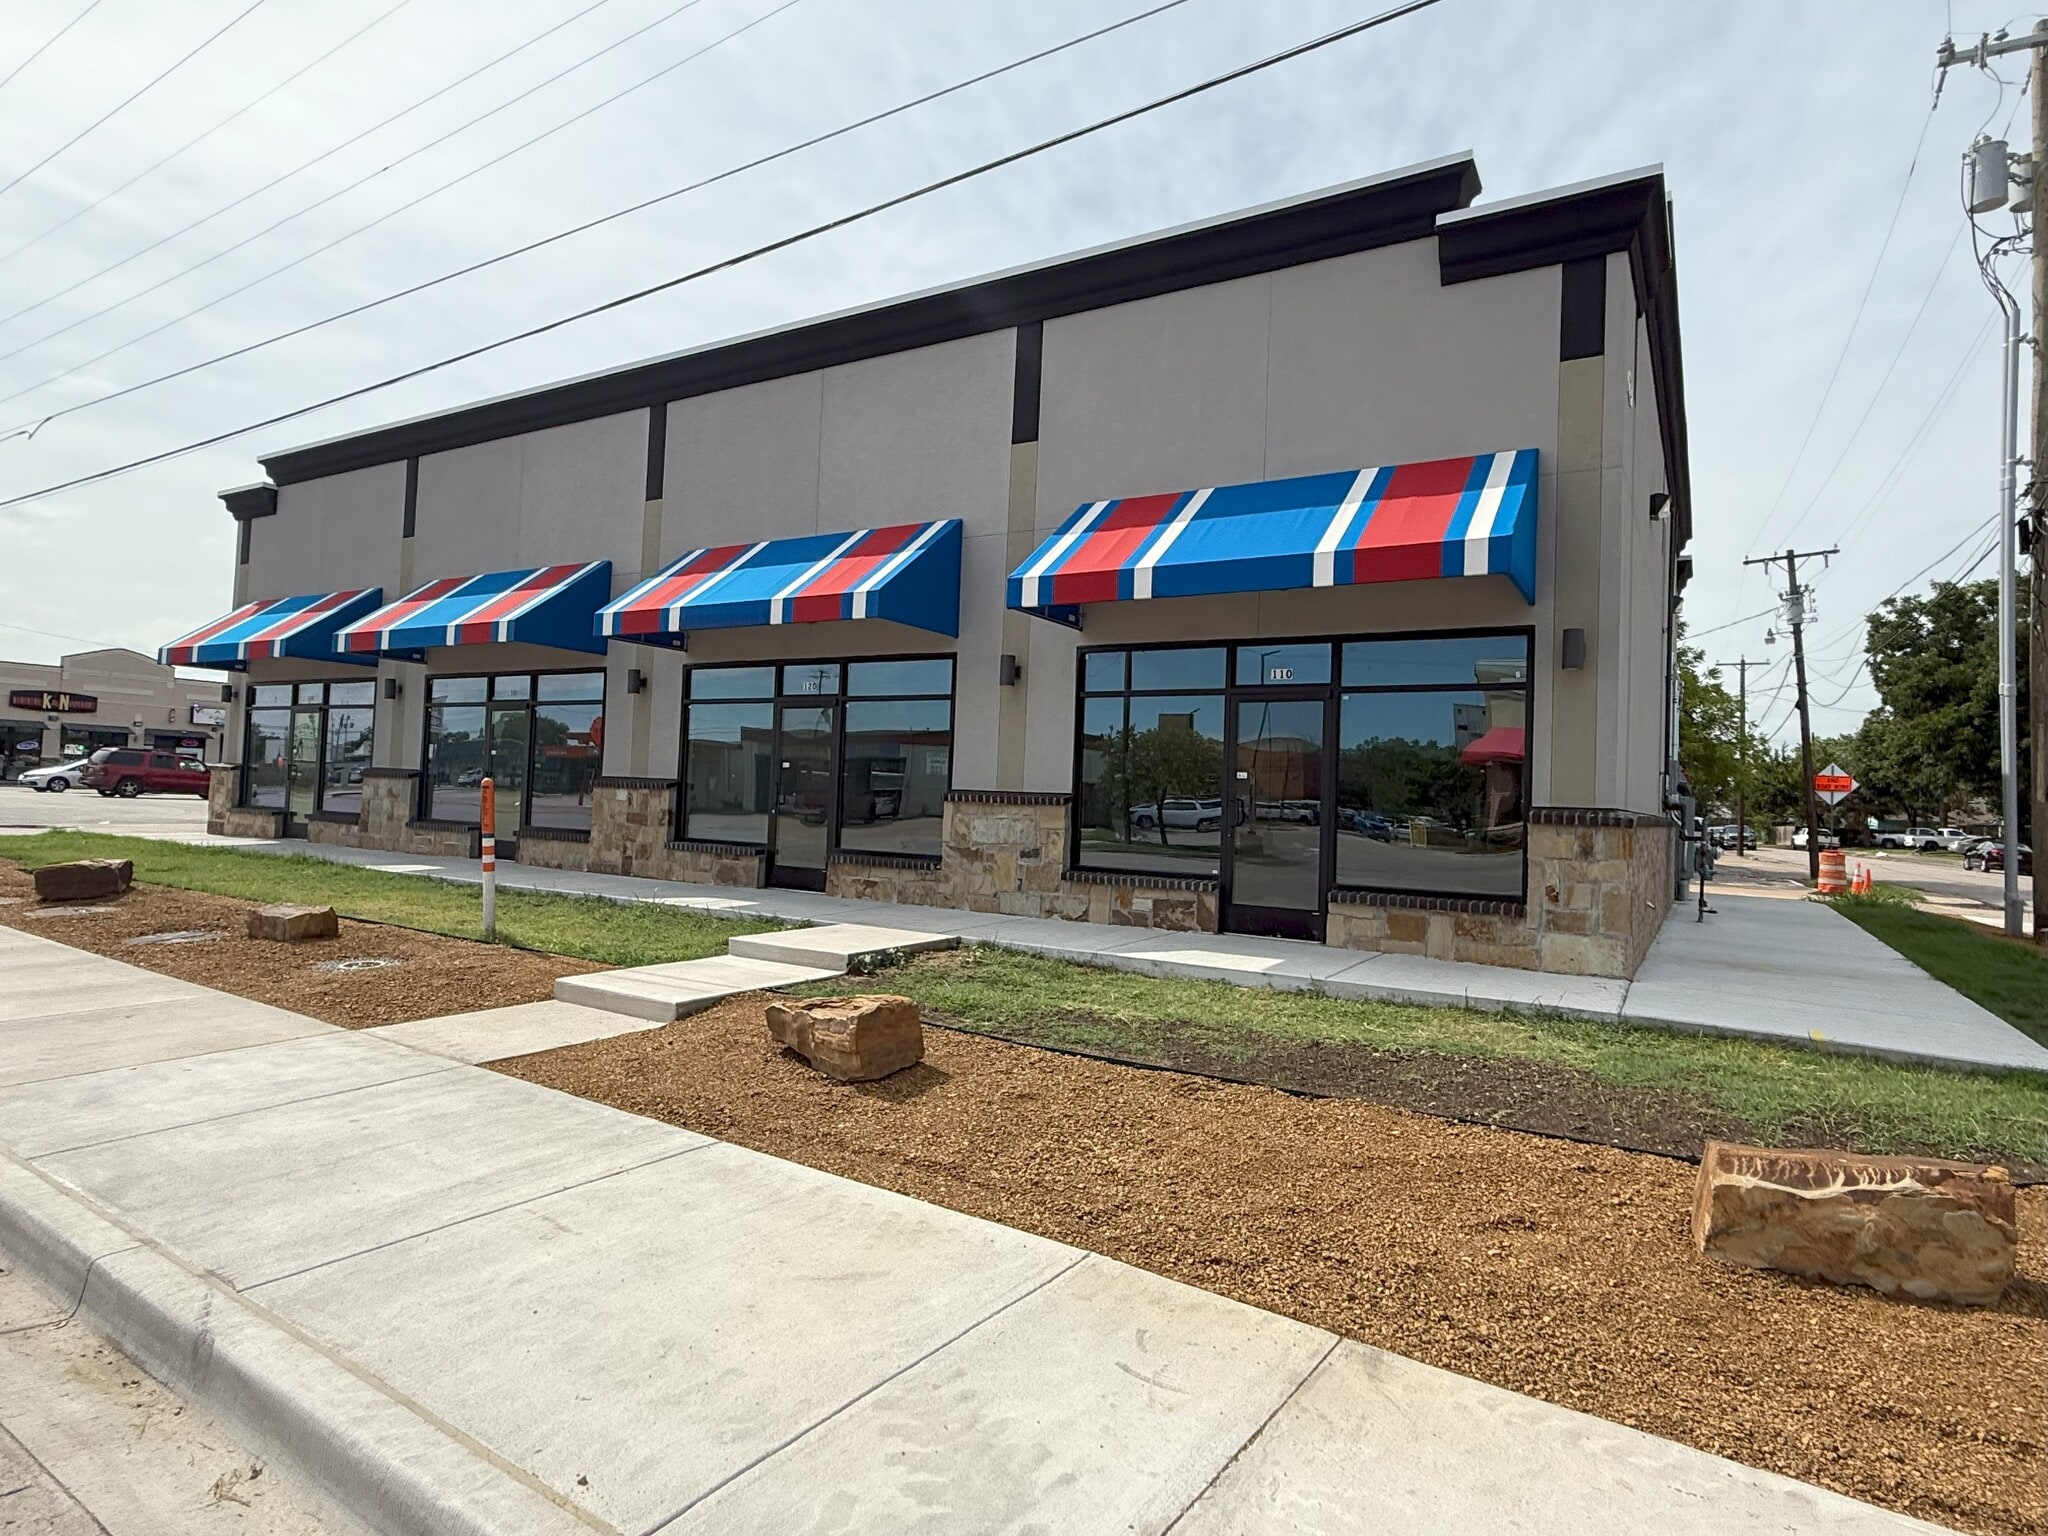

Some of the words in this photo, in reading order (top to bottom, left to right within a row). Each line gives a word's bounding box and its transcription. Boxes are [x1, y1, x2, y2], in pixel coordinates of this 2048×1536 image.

[1272, 669, 1293, 679] 110
[804, 682, 817, 691] 120
[42, 692, 53, 709] K
[58, 693, 71, 711] N
